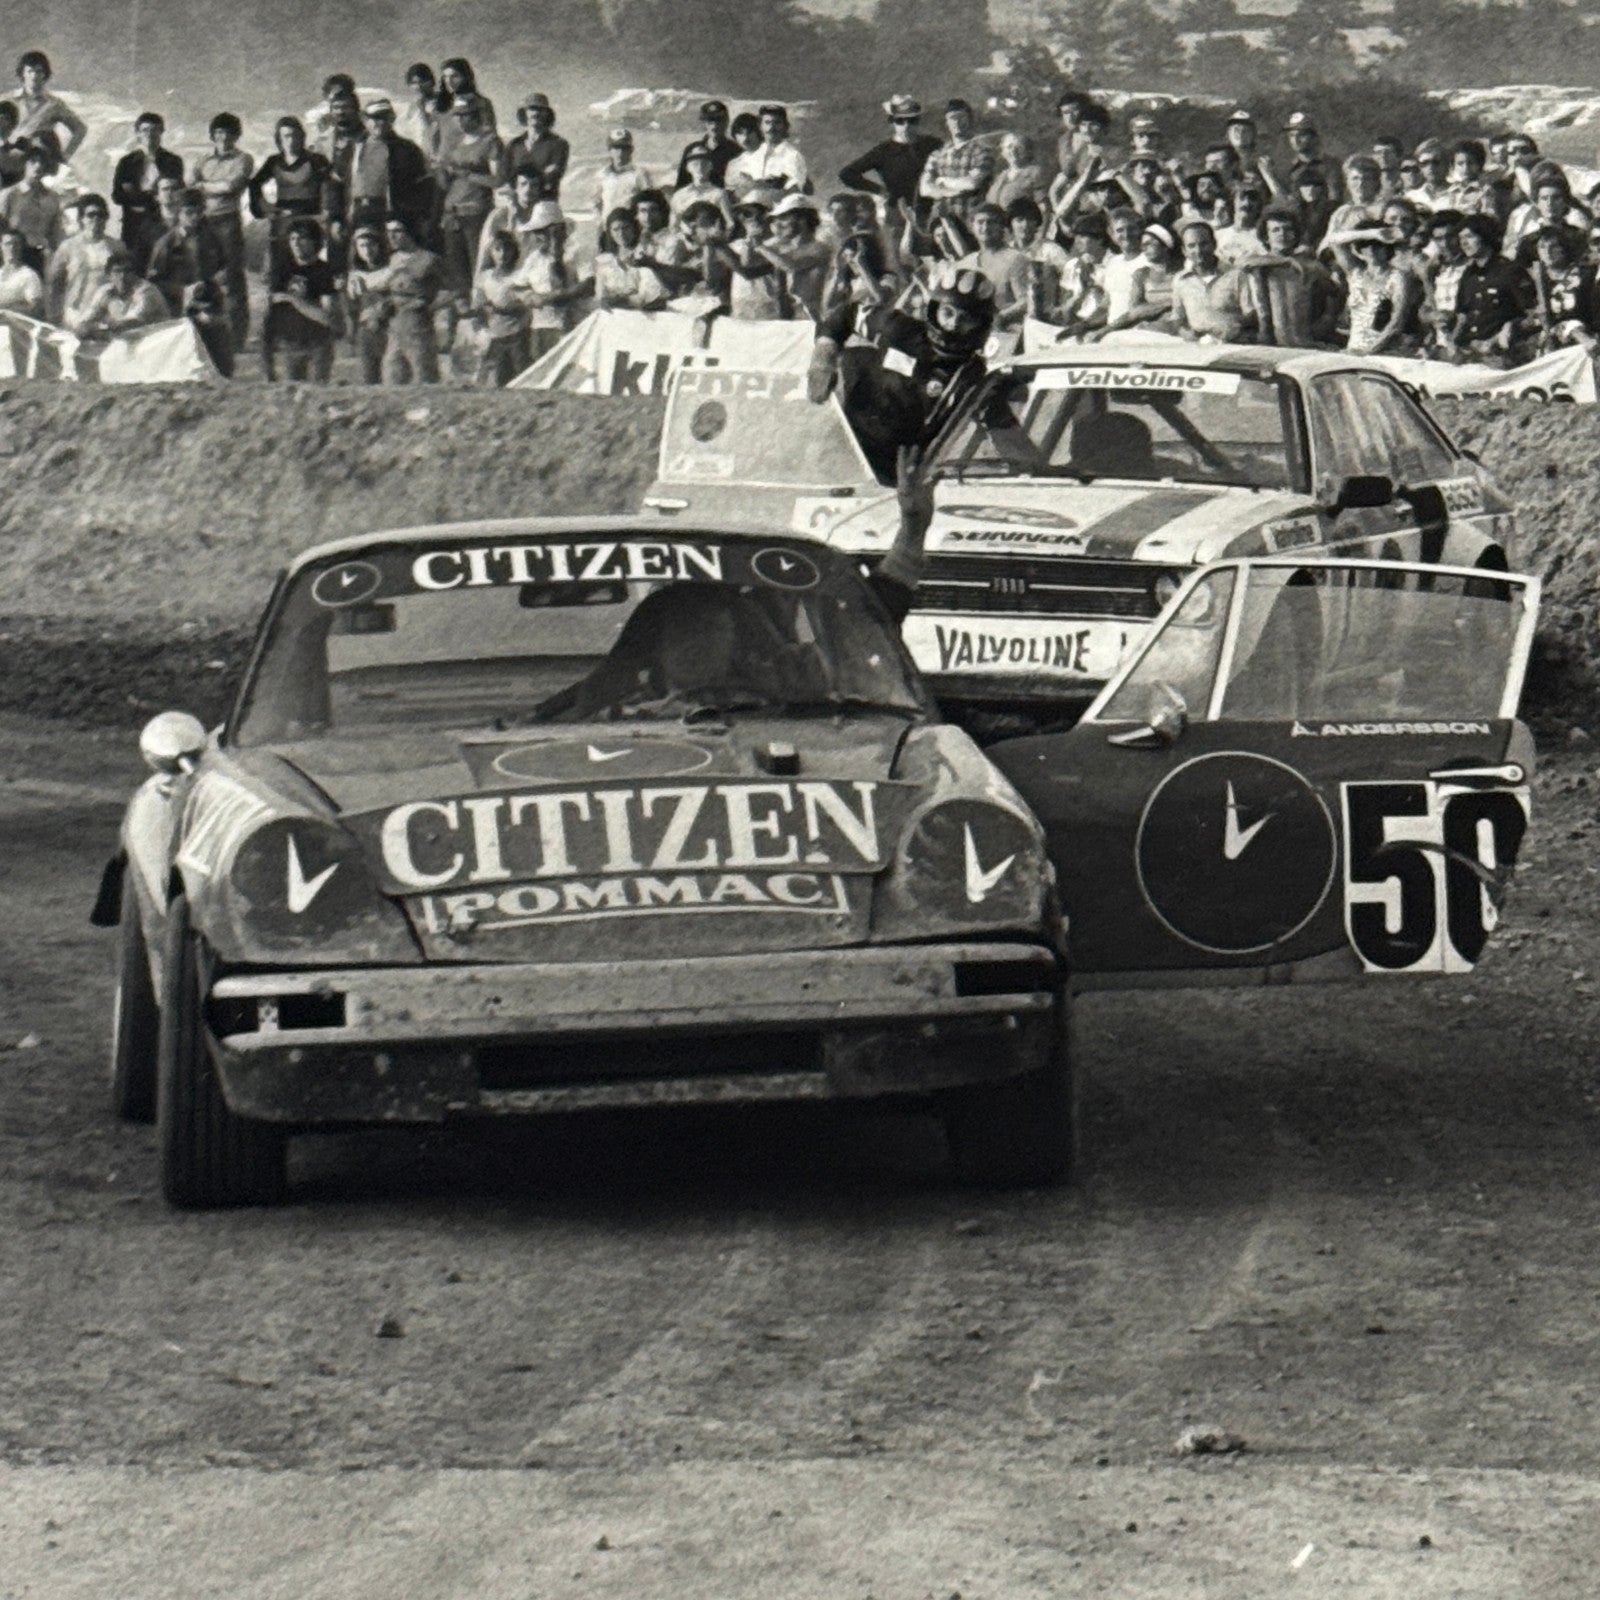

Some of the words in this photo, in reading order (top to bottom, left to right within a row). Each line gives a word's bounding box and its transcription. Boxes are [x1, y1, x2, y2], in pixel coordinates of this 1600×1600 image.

[1067, 370, 1206, 389] Valvoline
[412, 543, 723, 590] CITIZEN
[934, 624, 1091, 672] VALVOLINE
[1320, 722, 1491, 736] ANDERSSON
[380, 782, 881, 888] CITIZEN
[441, 873, 823, 926] POMMAC
